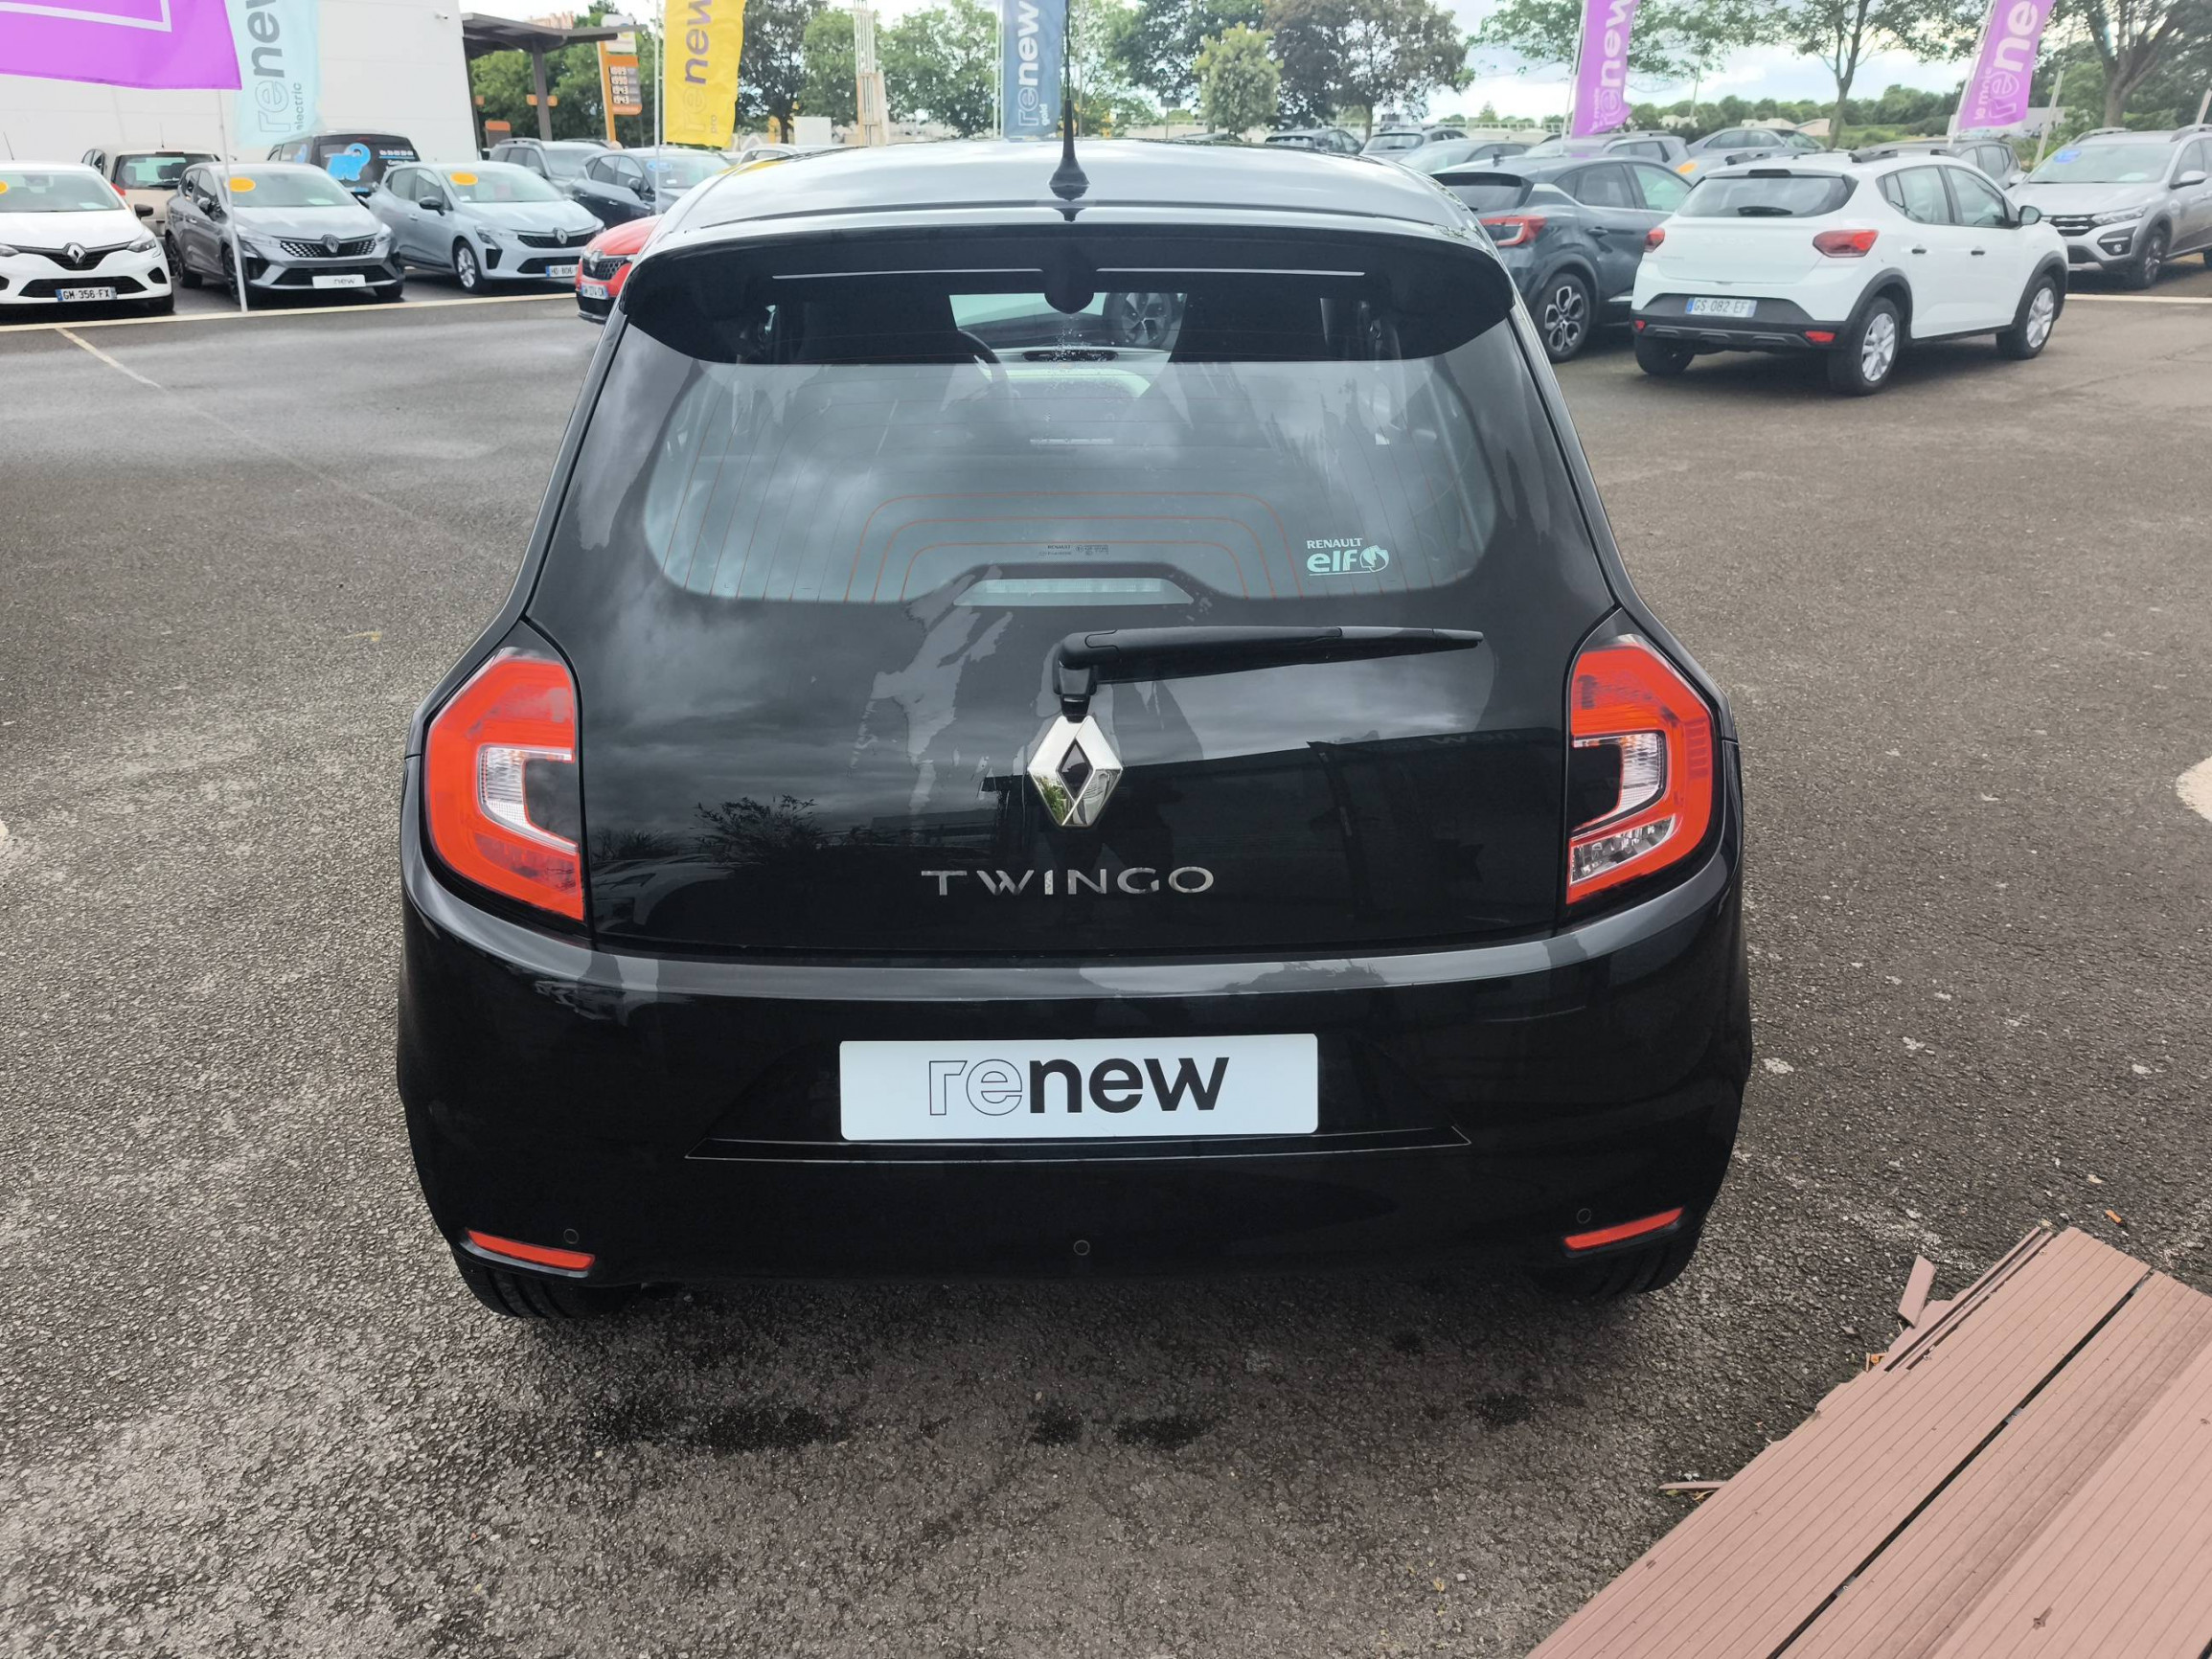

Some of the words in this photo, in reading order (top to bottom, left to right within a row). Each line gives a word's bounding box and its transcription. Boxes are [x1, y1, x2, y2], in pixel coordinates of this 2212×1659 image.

[245, 0, 291, 132] rene
[1017, 1, 1039, 125] renew
[1039, 103, 1050, 125] gold
[1306, 537, 1363, 549] RENAULT
[1307, 549, 1357, 573] elf
[921, 866, 1215, 896] TWINGO
[928, 1057, 1230, 1117] renew
